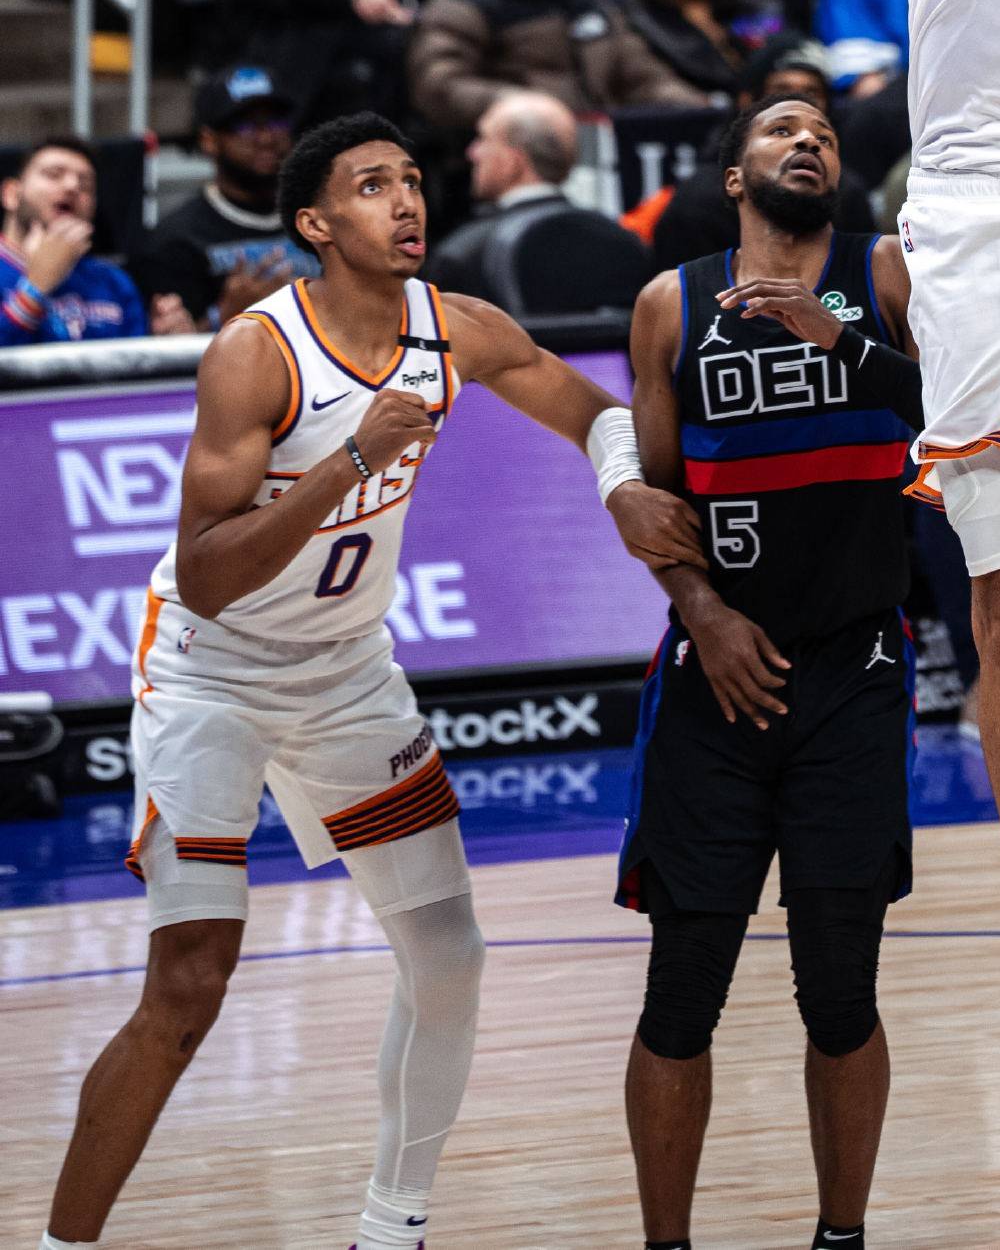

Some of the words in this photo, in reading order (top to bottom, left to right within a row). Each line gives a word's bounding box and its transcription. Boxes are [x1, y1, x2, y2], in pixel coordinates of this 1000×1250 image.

[402, 369, 438, 388] PayPal
[315, 532, 374, 598] 0
[710, 501, 760, 569] 5
[428, 693, 600, 750] tockX
